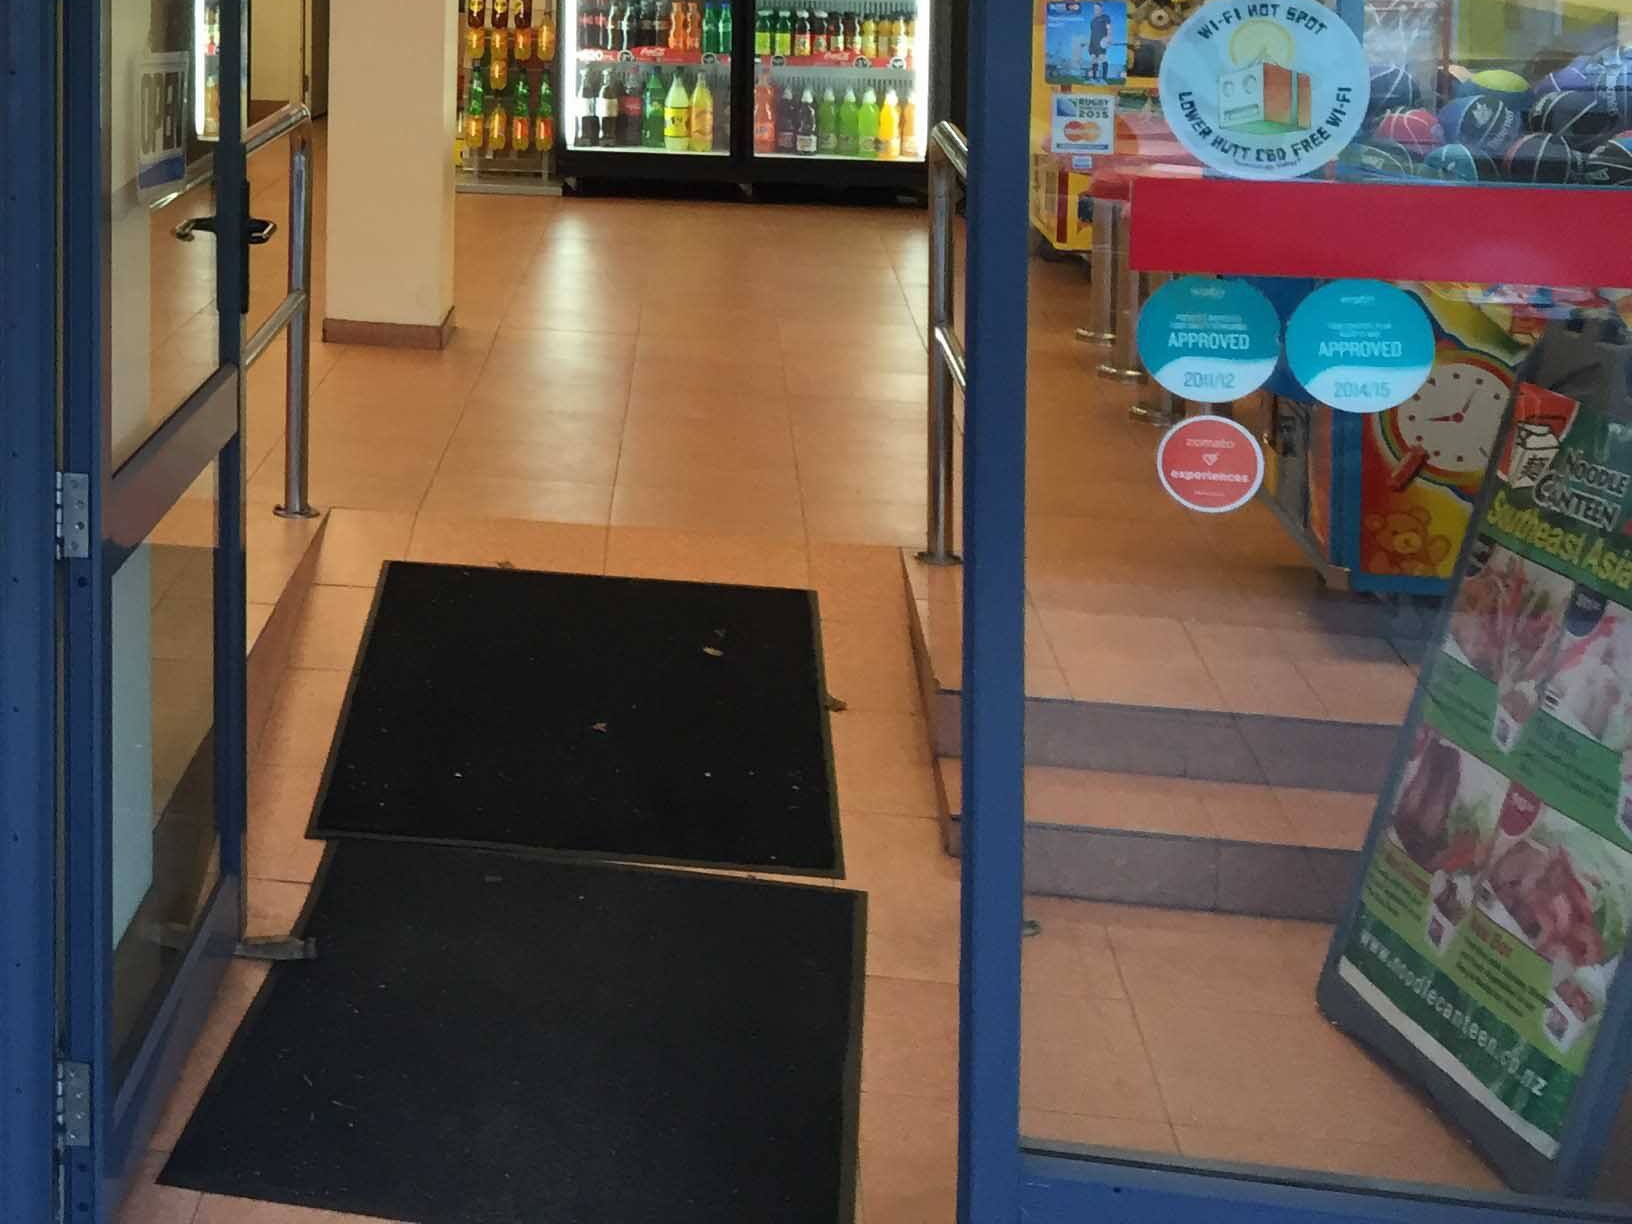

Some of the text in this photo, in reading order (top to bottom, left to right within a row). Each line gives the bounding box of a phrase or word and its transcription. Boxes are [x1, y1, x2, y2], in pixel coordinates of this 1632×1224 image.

[1196, 3, 1328, 39] WI-FI HOT SPOT
[1178, 87, 1352, 162] LOWER HUTT CBD FREE WI-FI
[1168, 332, 1250, 351] APPROVED
[1318, 341, 1403, 359] APPROVED
[1568, 447, 1630, 497] NOODLE
[1533, 471, 1622, 532] CANTEEN
